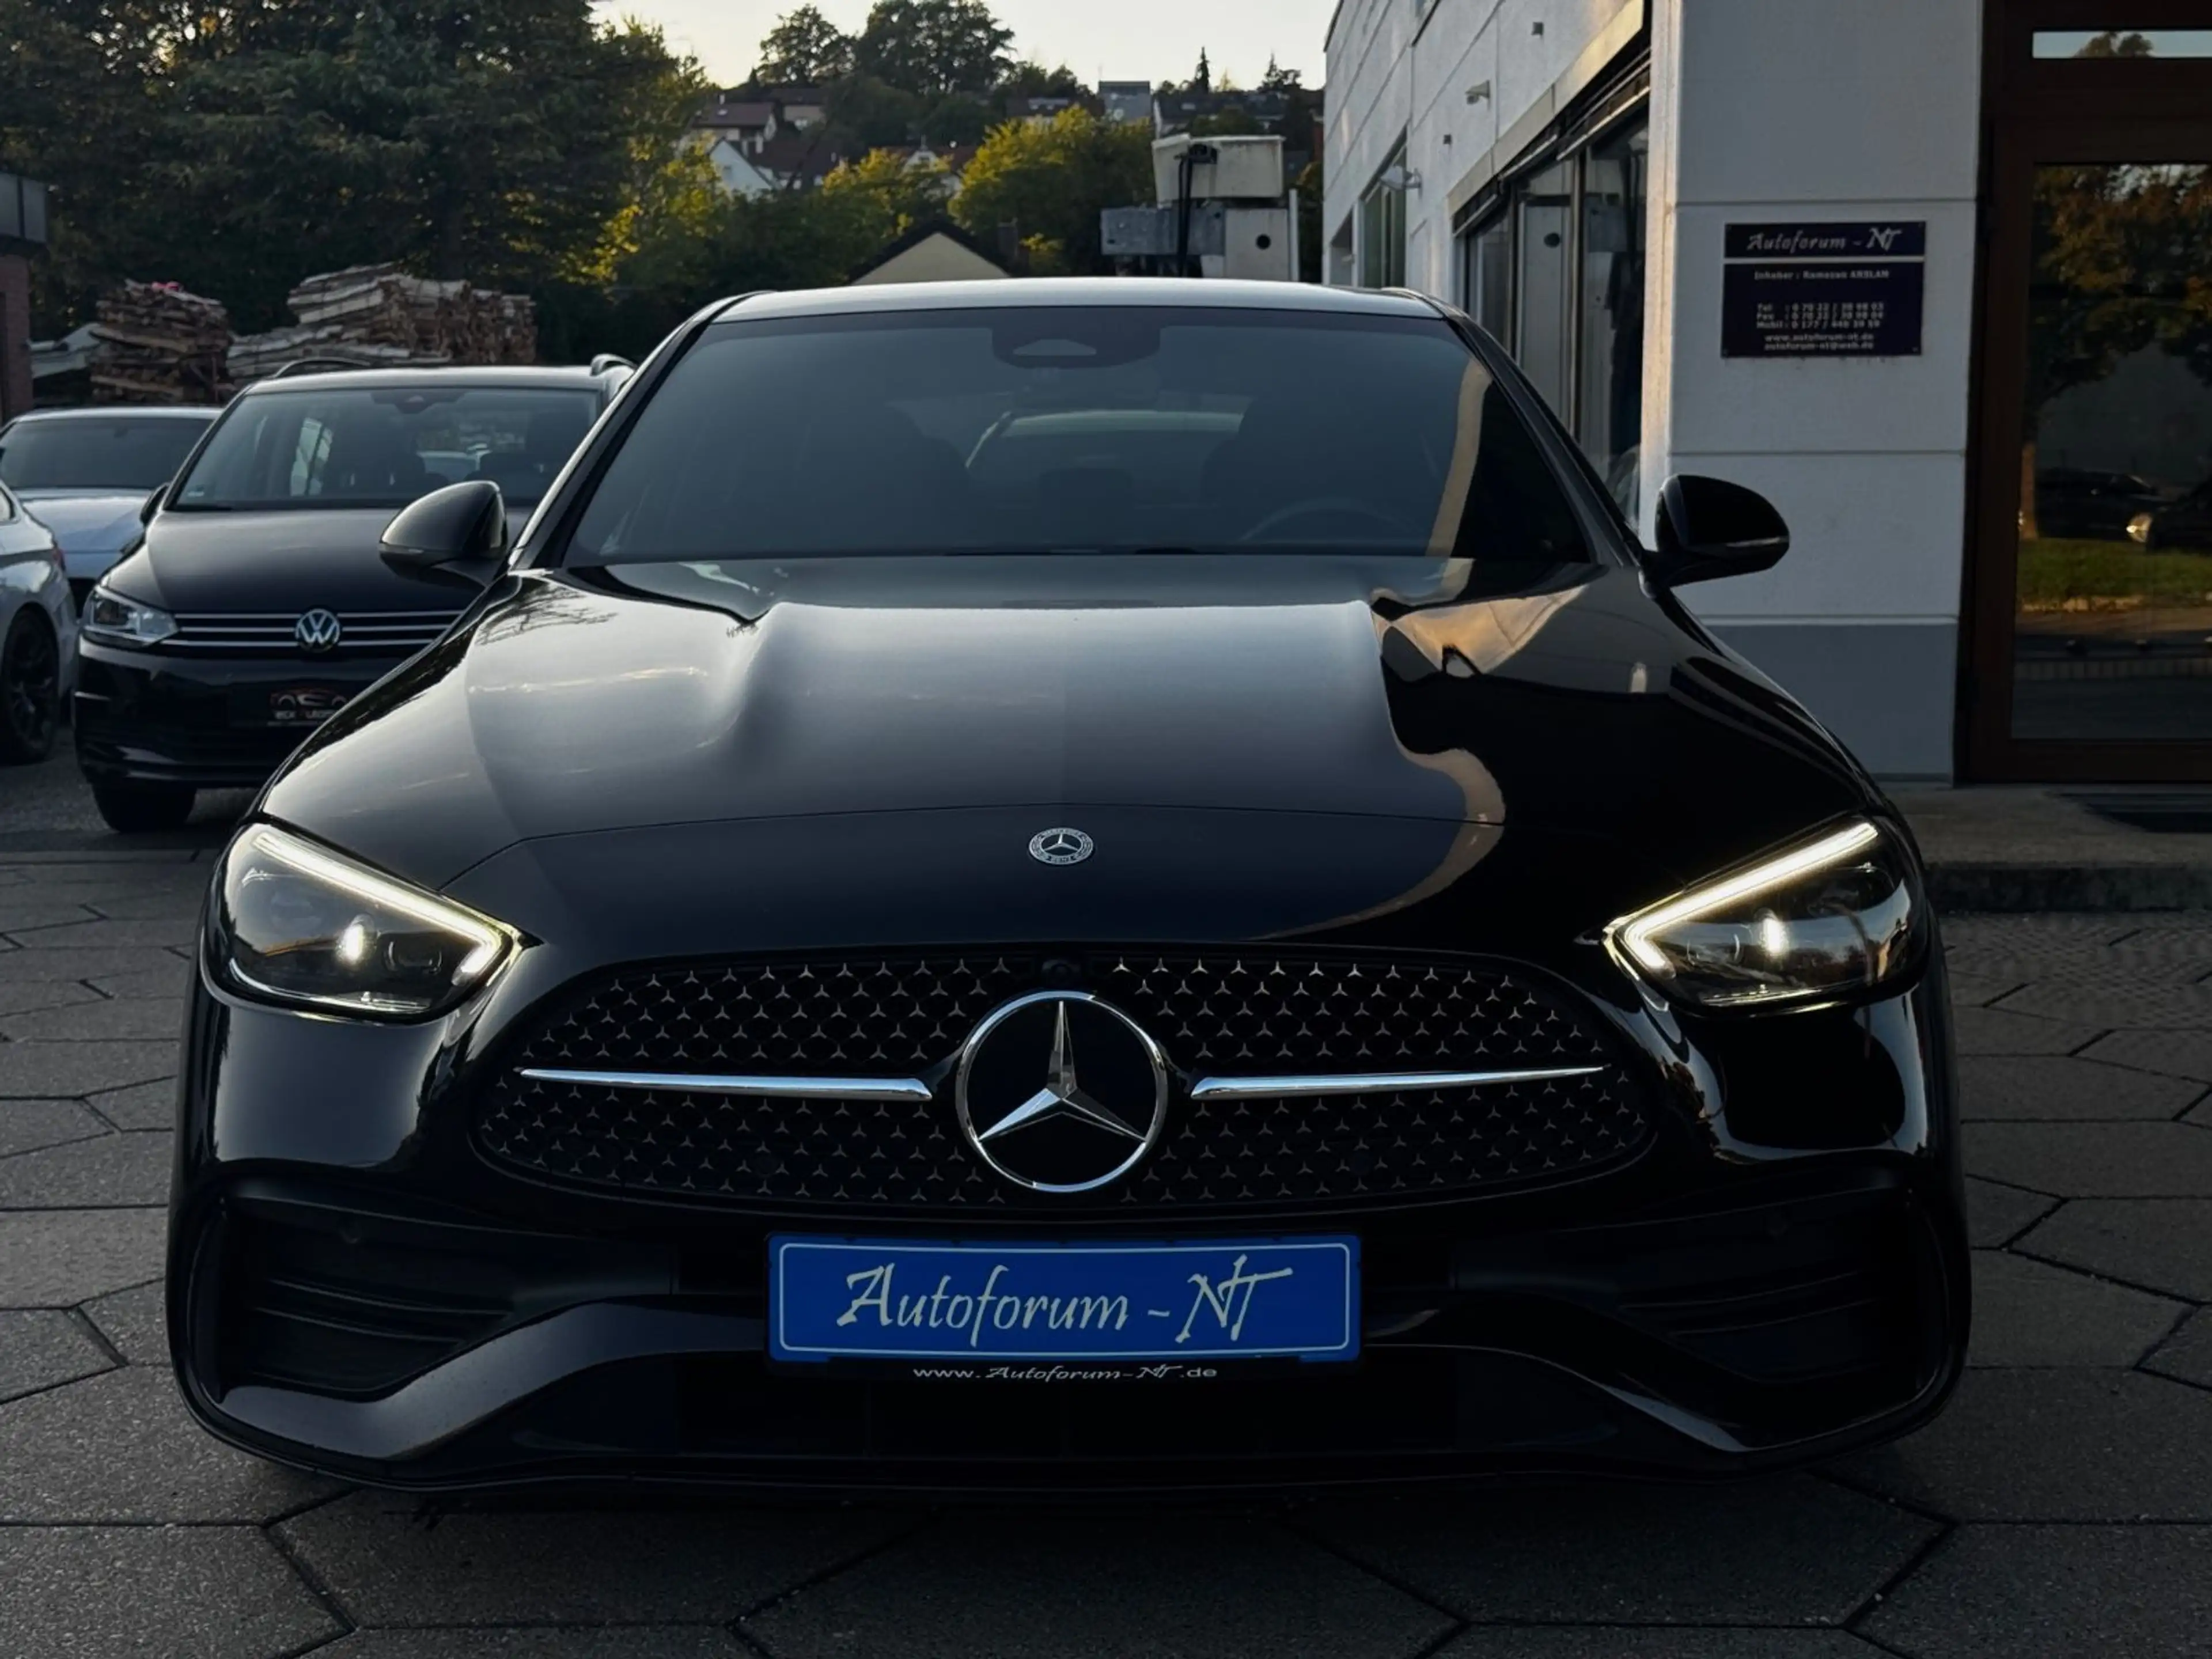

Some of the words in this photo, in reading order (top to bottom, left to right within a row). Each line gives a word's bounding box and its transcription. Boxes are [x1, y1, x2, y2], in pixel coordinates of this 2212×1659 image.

[1747, 230, 1846, 253] Autoforum
[1866, 227, 1903, 251] NT
[836, 1263, 1129, 1349] Autoforum
[1175, 1254, 1294, 1343] NT
[912, 1363, 1218, 1382] www.Autoforum-NT.de
